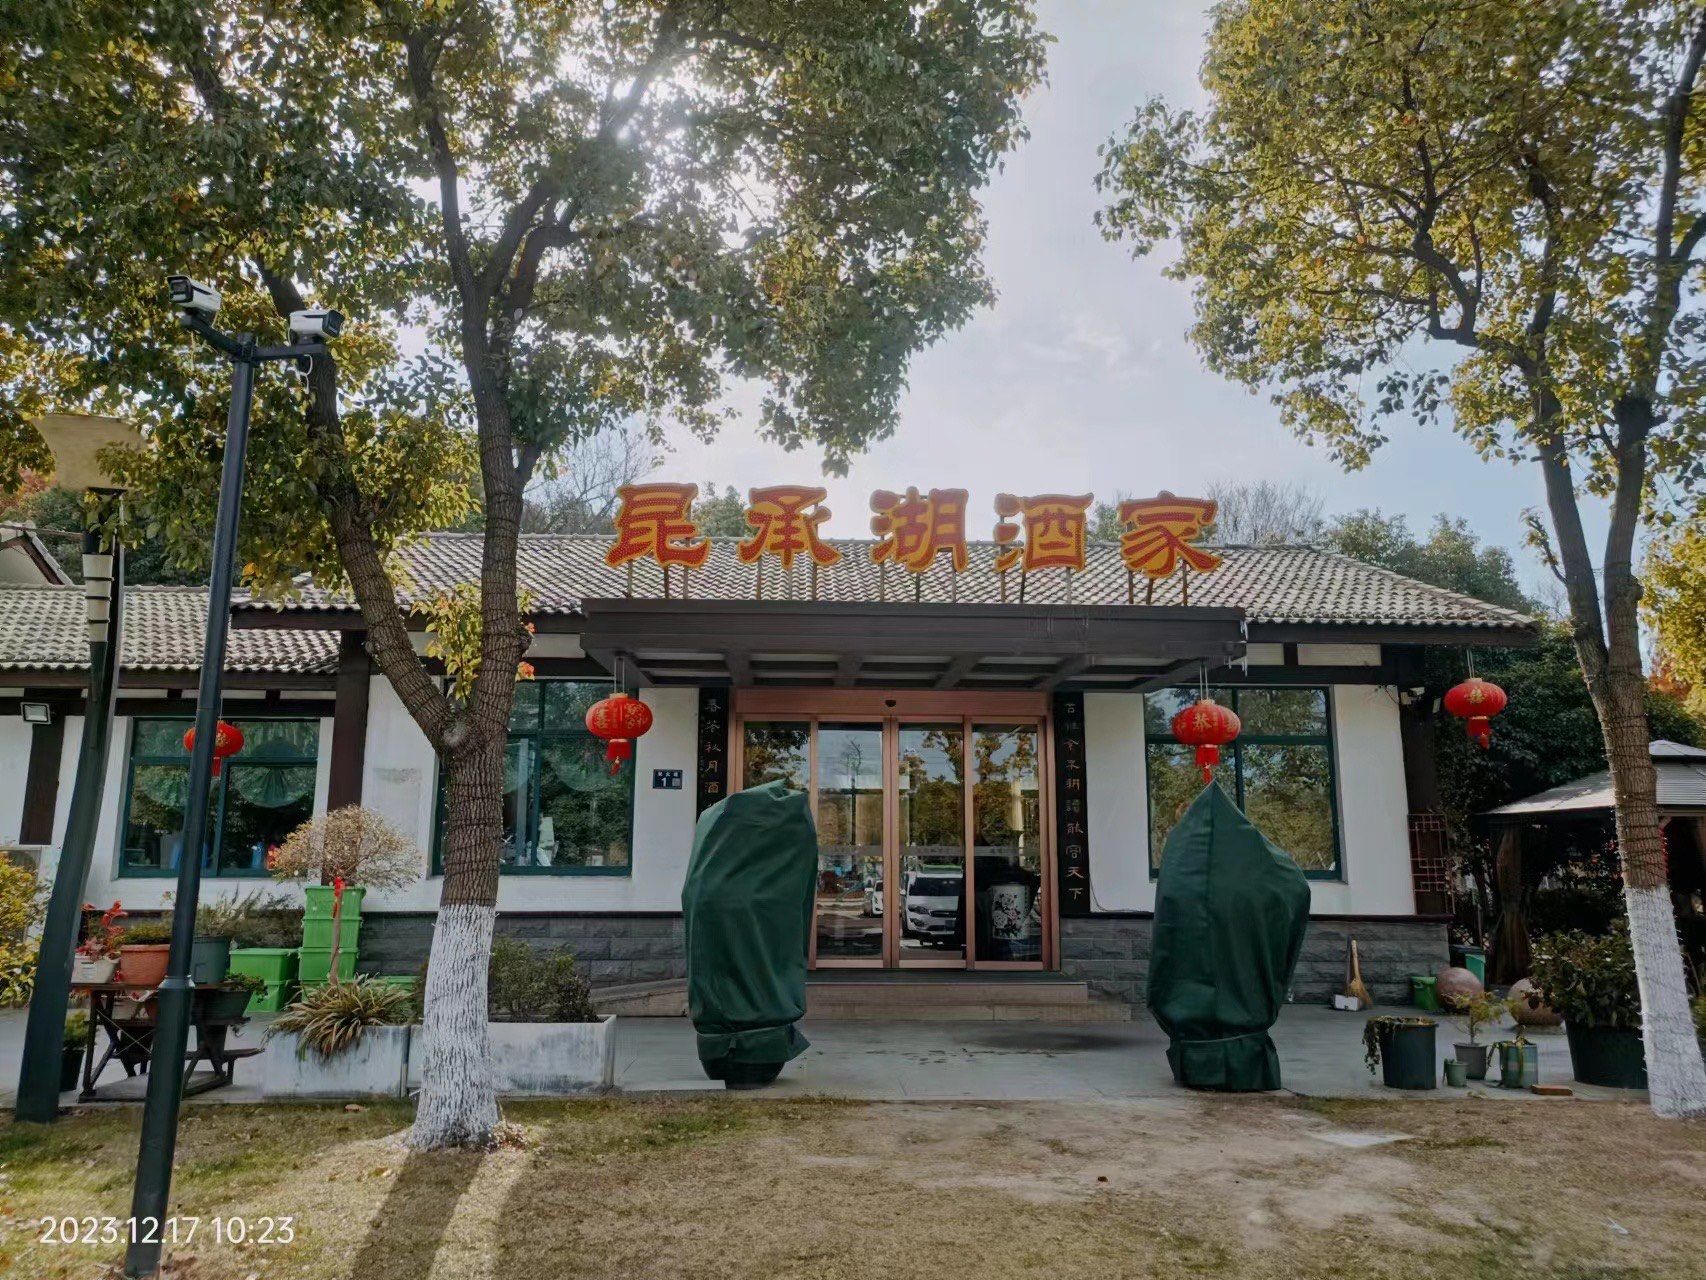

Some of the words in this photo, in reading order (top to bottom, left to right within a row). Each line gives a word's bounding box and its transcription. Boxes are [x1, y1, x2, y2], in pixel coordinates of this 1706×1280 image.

[605, 482, 1223, 579] 昆承湖酒家
